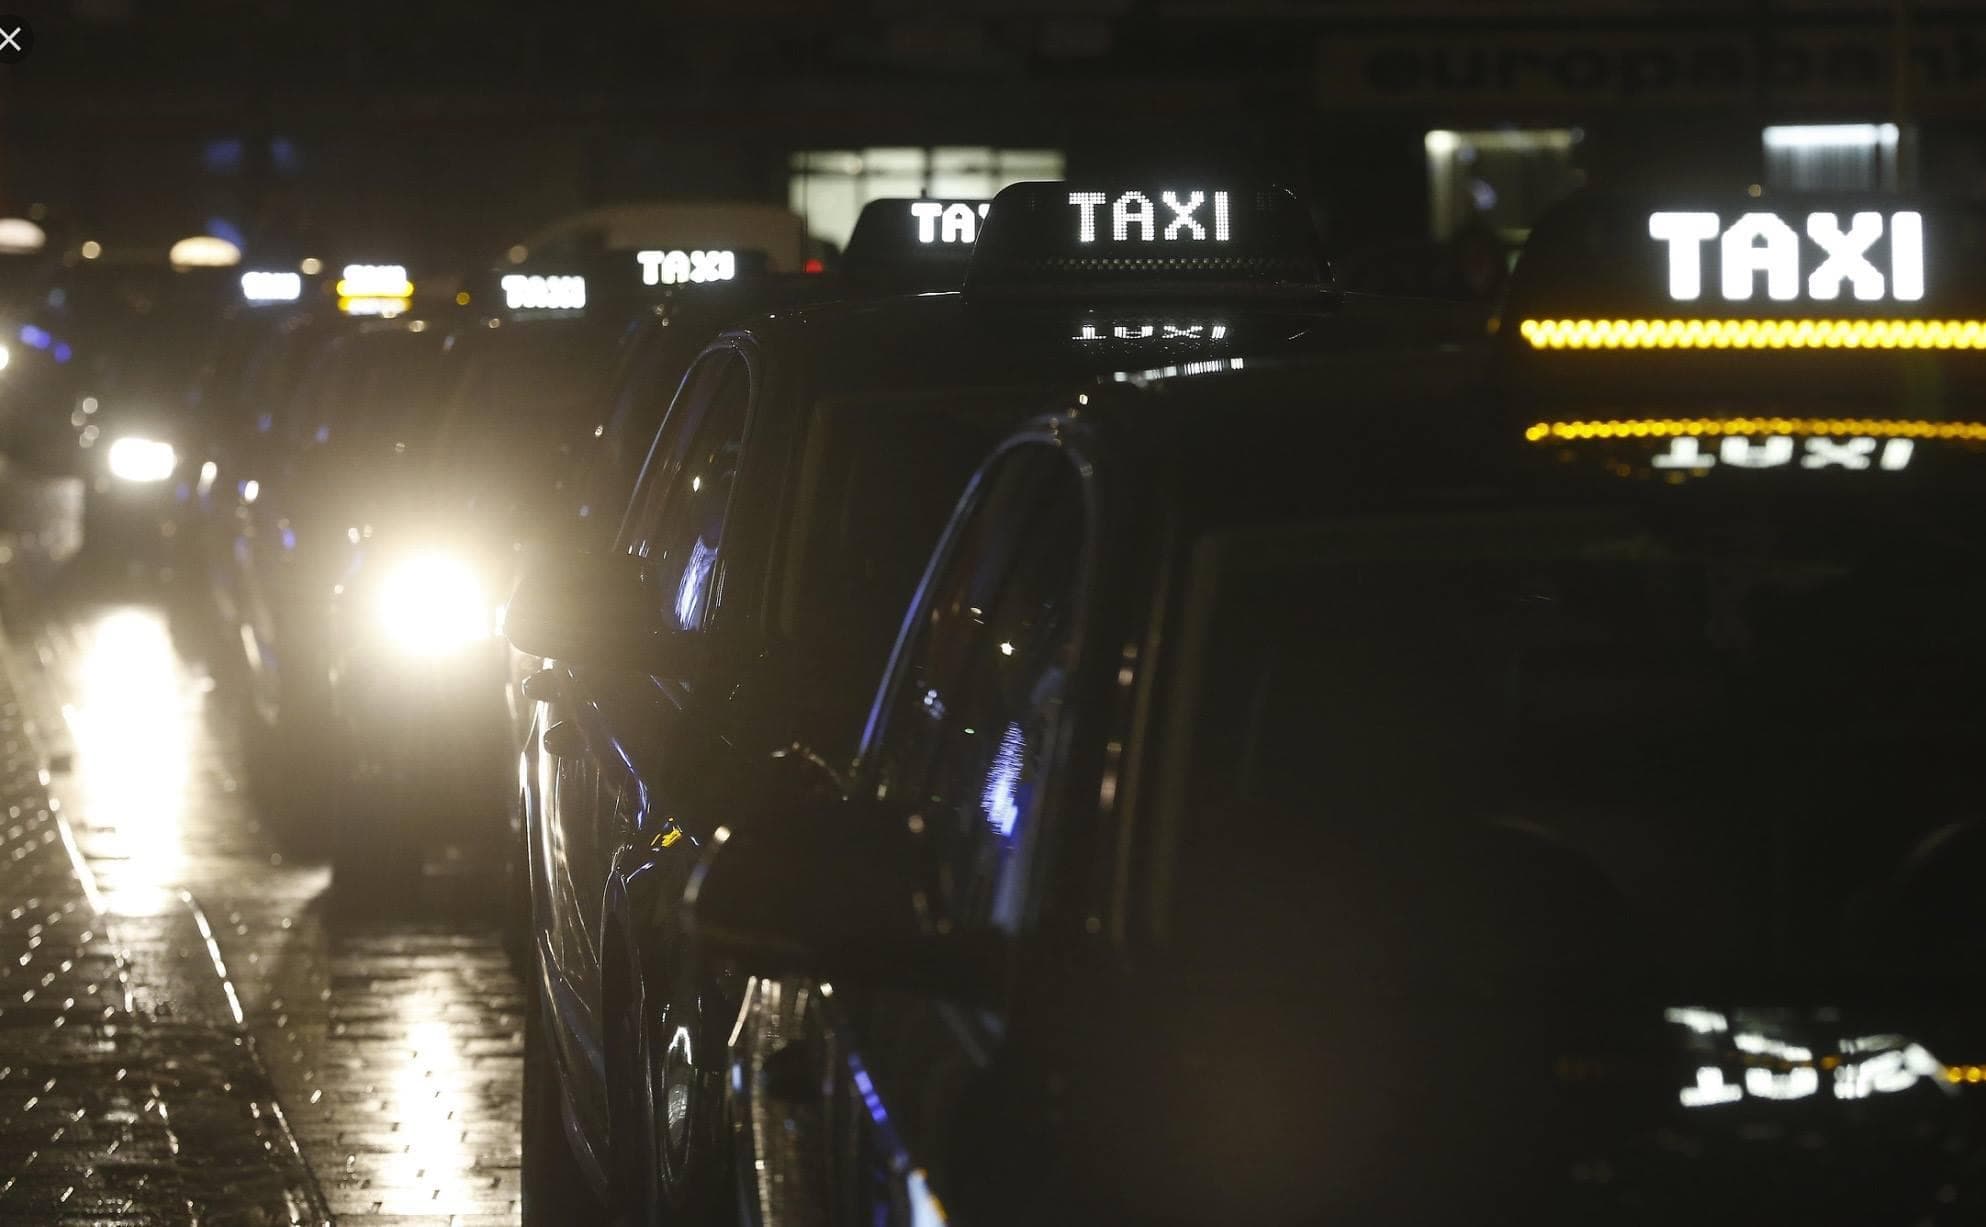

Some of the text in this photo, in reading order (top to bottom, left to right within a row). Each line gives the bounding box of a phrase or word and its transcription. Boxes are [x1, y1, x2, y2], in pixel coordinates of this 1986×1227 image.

[911, 202, 990, 243] TA
[1068, 190, 1230, 242] TAXI
[637, 250, 736, 285] TAXI
[1648, 211, 1925, 301] TAXI
